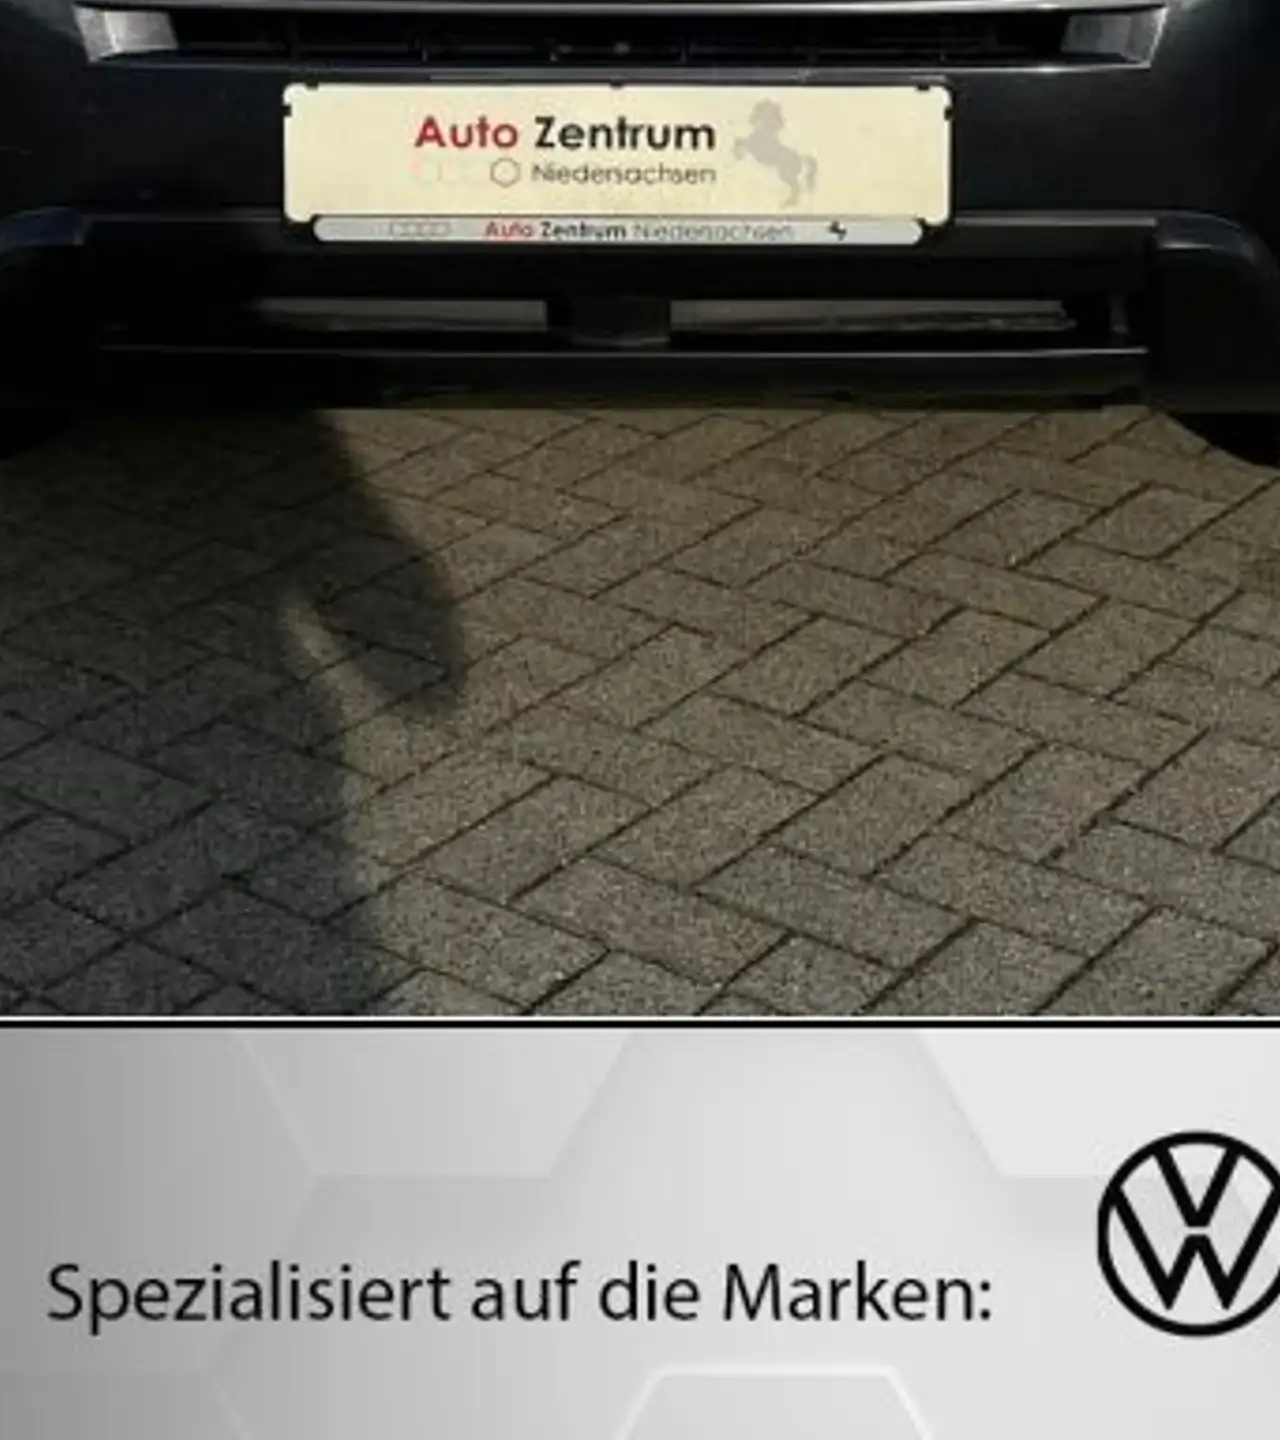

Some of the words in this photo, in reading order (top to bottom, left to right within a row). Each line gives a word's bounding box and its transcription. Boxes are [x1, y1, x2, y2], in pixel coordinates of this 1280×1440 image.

[414, 115, 519, 151] Auto
[533, 114, 716, 151] Zentrum
[531, 159, 716, 187] Niedersachsen
[484, 221, 534, 240] Auto
[540, 220, 627, 241] Zentrum
